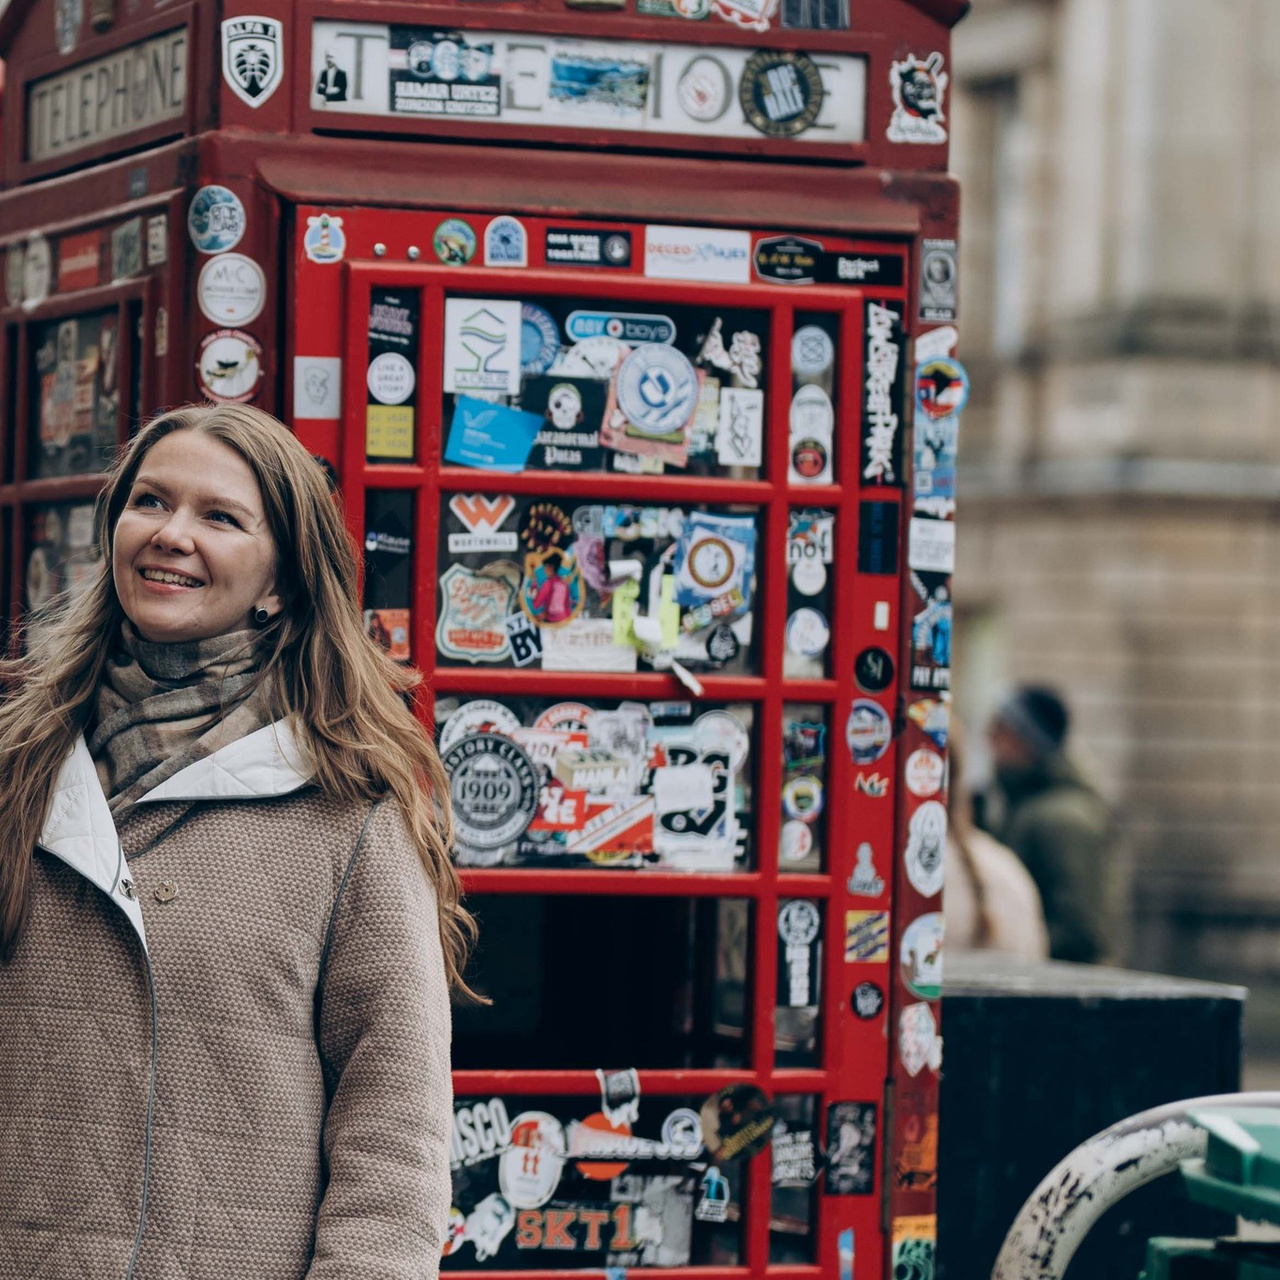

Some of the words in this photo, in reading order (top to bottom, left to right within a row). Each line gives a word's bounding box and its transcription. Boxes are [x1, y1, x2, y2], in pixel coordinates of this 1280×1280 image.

[36, 37, 186, 153] TELEPHONE
[547, 233, 568, 244] ONE
[460, 779, 512, 801] 1909
[516, 1203, 638, 1251] SKT1
